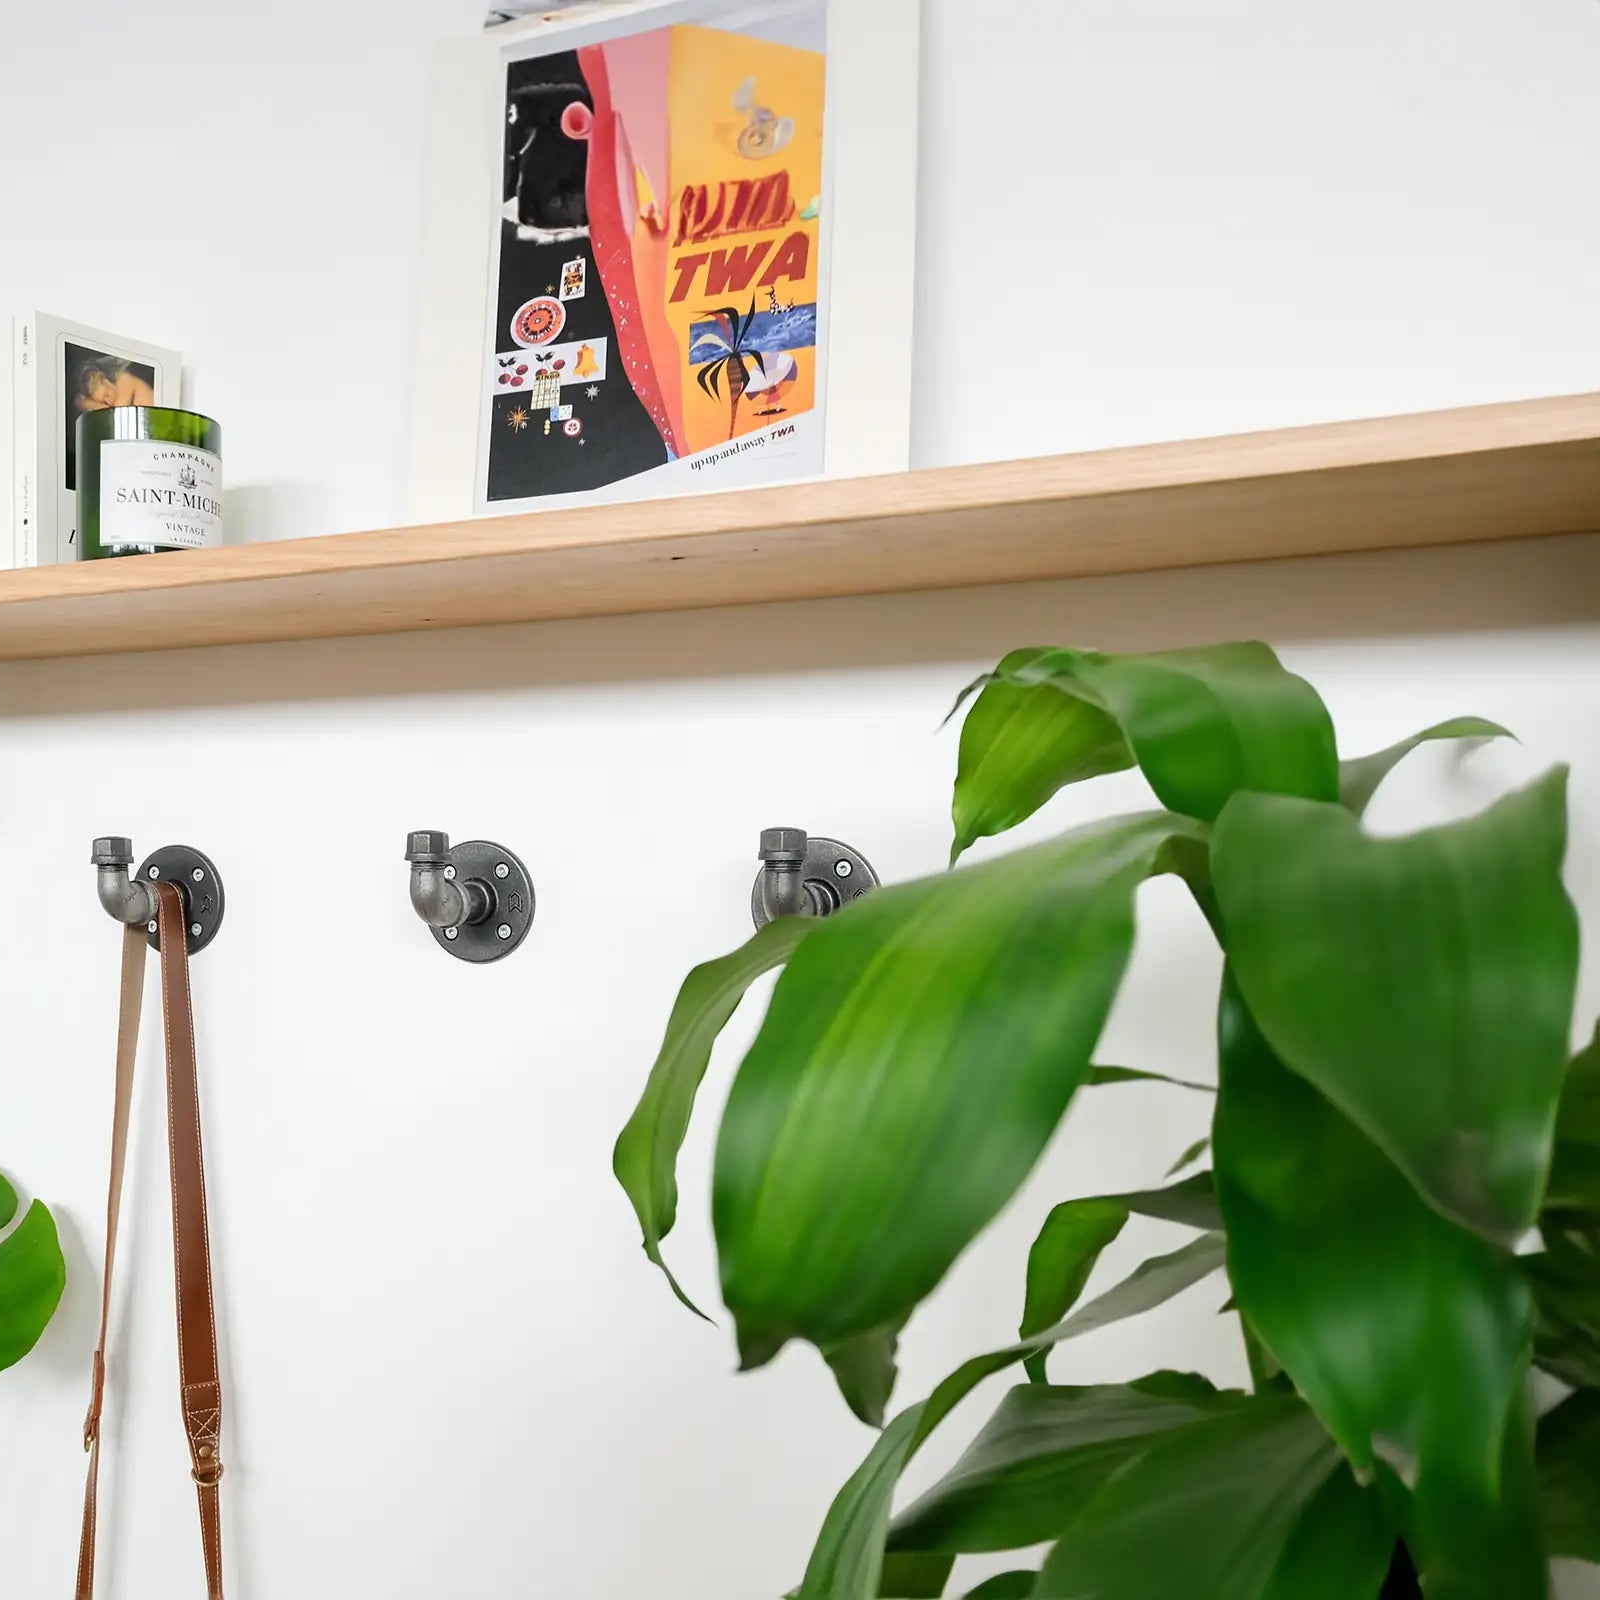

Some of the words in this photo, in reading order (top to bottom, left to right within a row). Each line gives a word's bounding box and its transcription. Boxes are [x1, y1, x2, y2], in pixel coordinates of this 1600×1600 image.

[669, 231, 810, 303] TWA
[770, 424, 795, 440] TWA
[165, 522, 206, 537] VINTAGE
